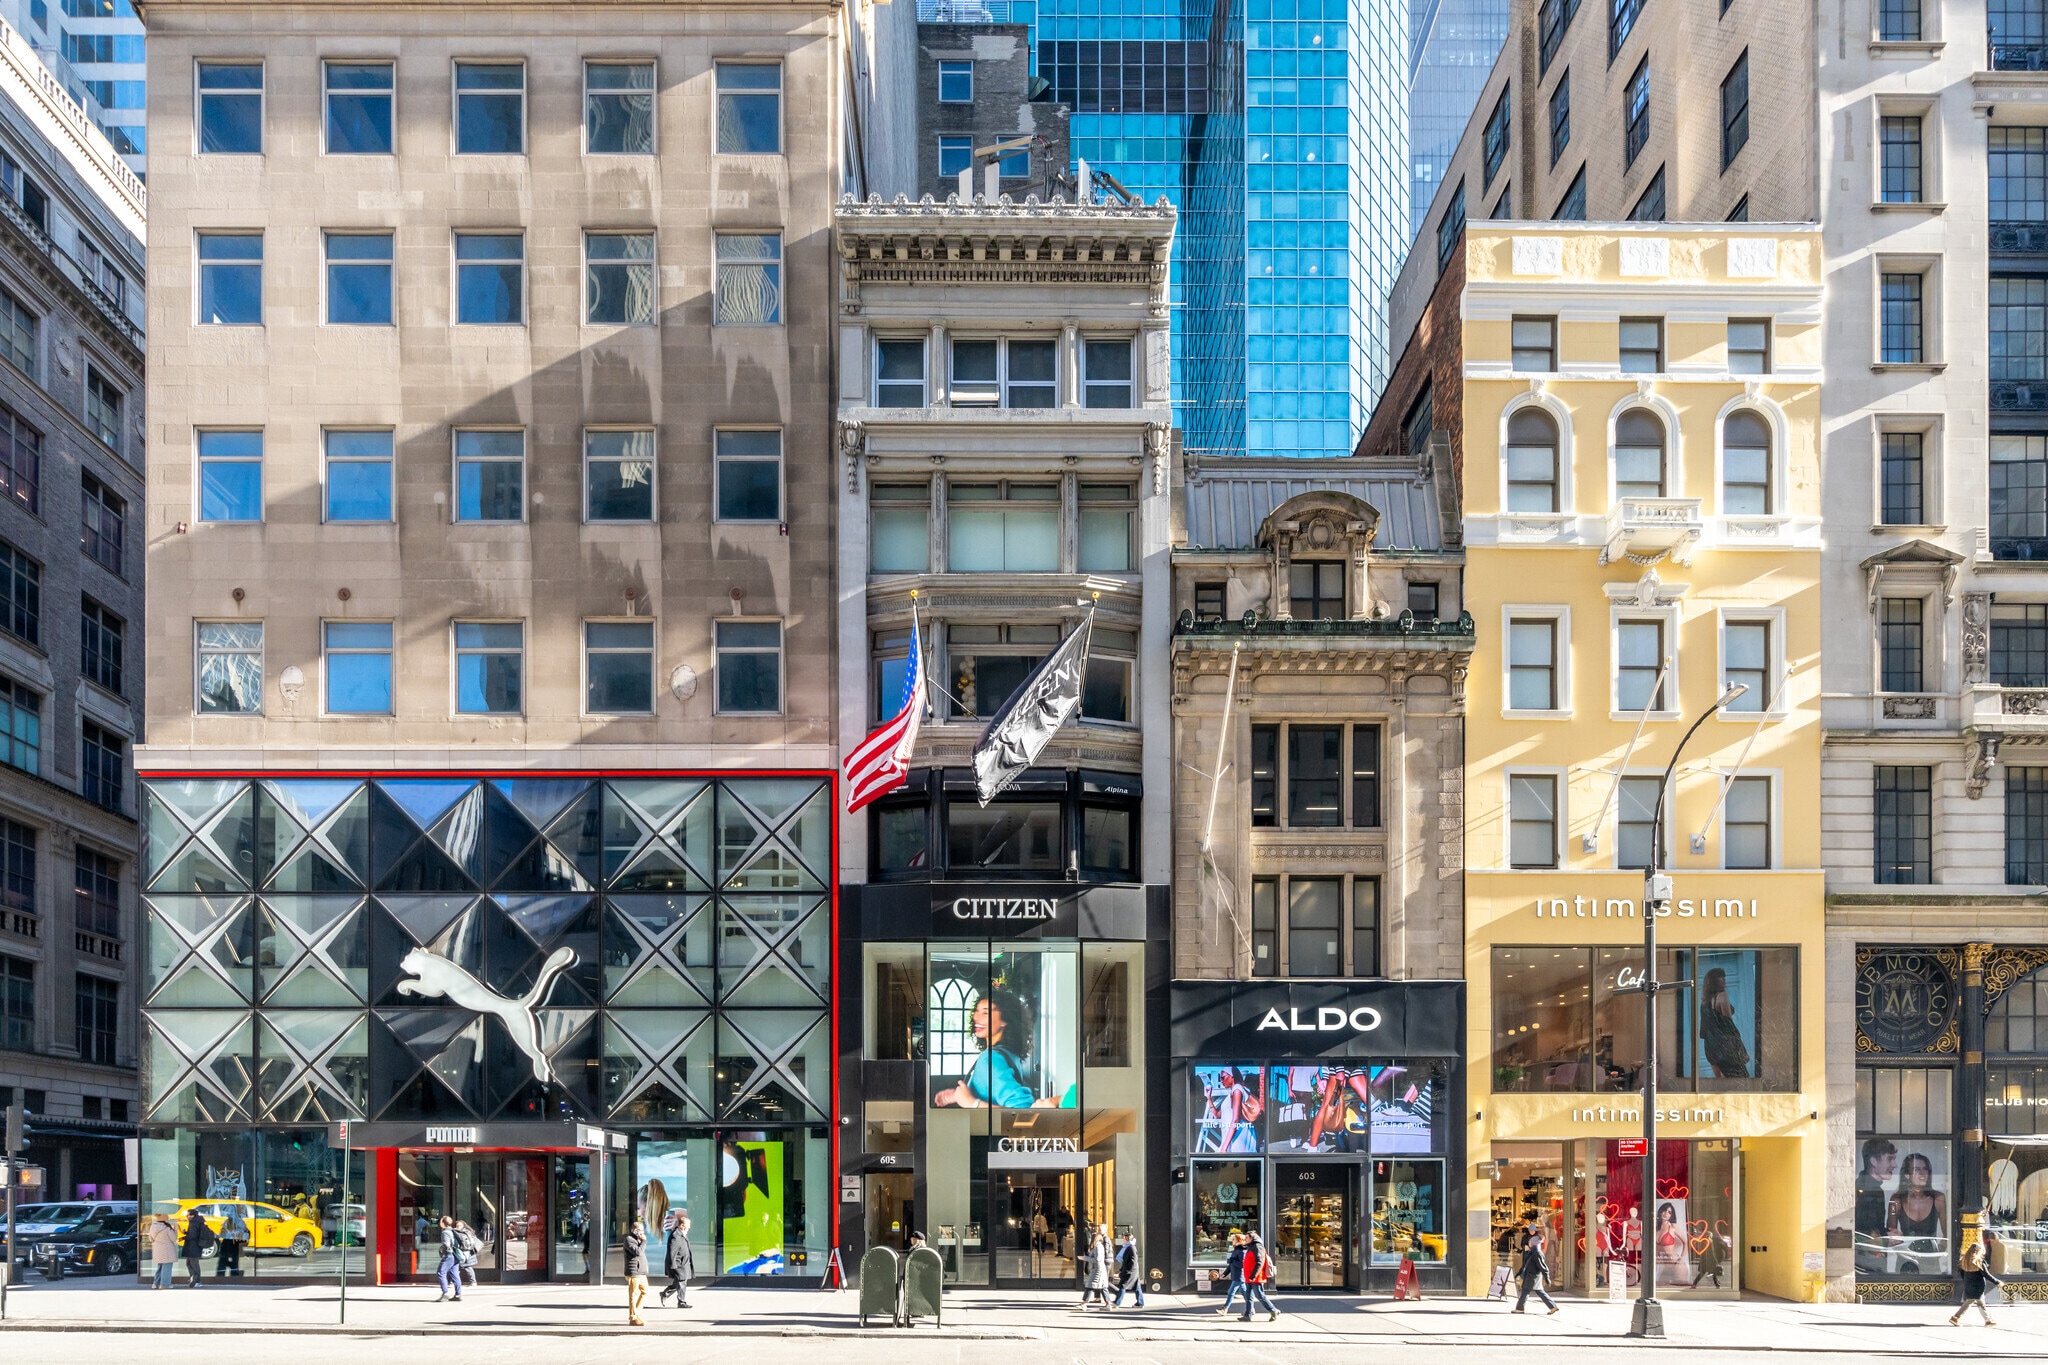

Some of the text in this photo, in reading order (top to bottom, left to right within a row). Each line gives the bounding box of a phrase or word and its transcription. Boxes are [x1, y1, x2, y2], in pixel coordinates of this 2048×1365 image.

[953, 898, 1059, 919] CITIZEN
[1617, 966, 1646, 988] Caf
[1256, 1006, 1382, 1032] ALDO
[1985, 1098, 2023, 1106] CLUB
[1572, 1107, 1723, 1122] intimssimi
[426, 1126, 476, 1143] PUMA
[998, 1137, 1079, 1153] CITIZEN
[880, 1156, 896, 1165] 605
[1298, 1172, 1316, 1181] 603
